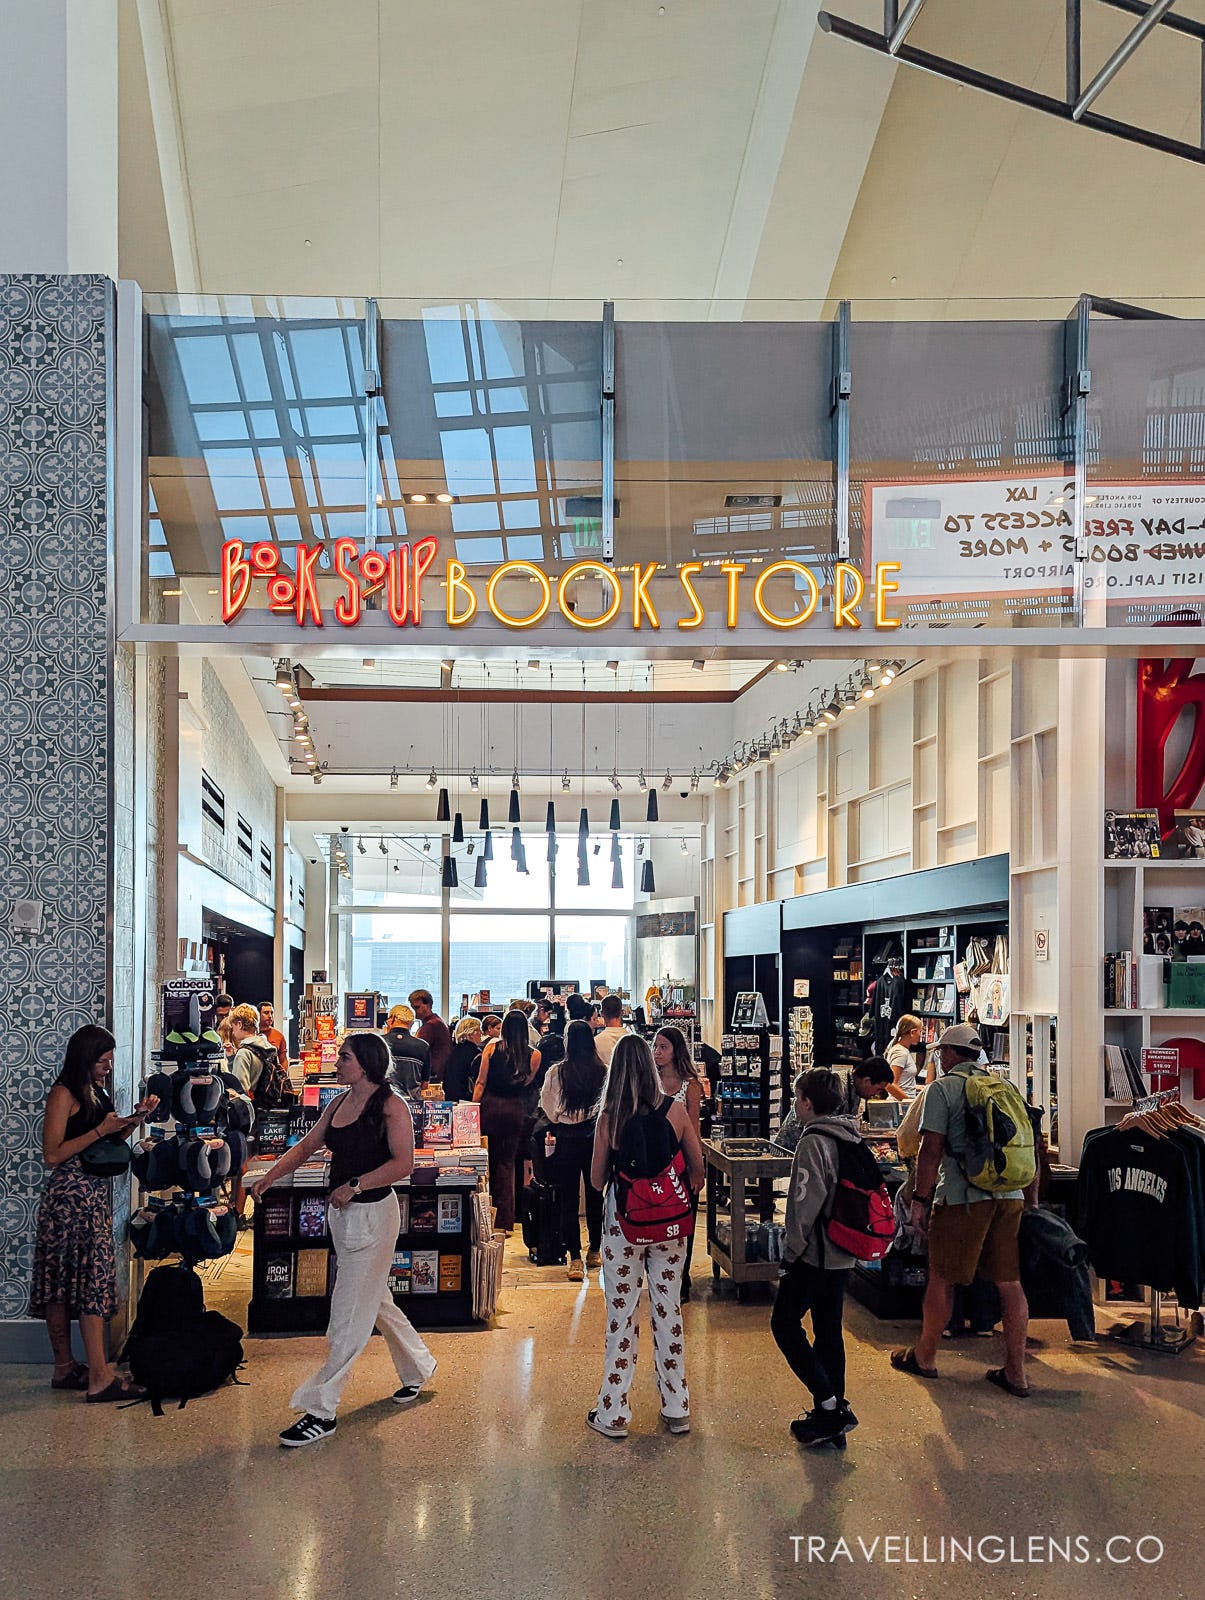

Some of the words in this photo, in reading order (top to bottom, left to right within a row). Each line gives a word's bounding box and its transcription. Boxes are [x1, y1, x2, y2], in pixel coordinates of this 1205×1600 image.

[221, 537, 325, 627] BOOK
[333, 535, 439, 627] SOUP
[446, 559, 901, 629] BOOKSTORE
[167, 979, 215, 990] cabeau
[263, 1127, 284, 1135] LAKE
[259, 1134, 288, 1142] ESCAPE
[1123, 1167, 1168, 1204] ANGELES
[666, 1224, 680, 1237] SB
[267, 1266, 288, 1274] IRON
[266, 1274, 290, 1282] FLAME
